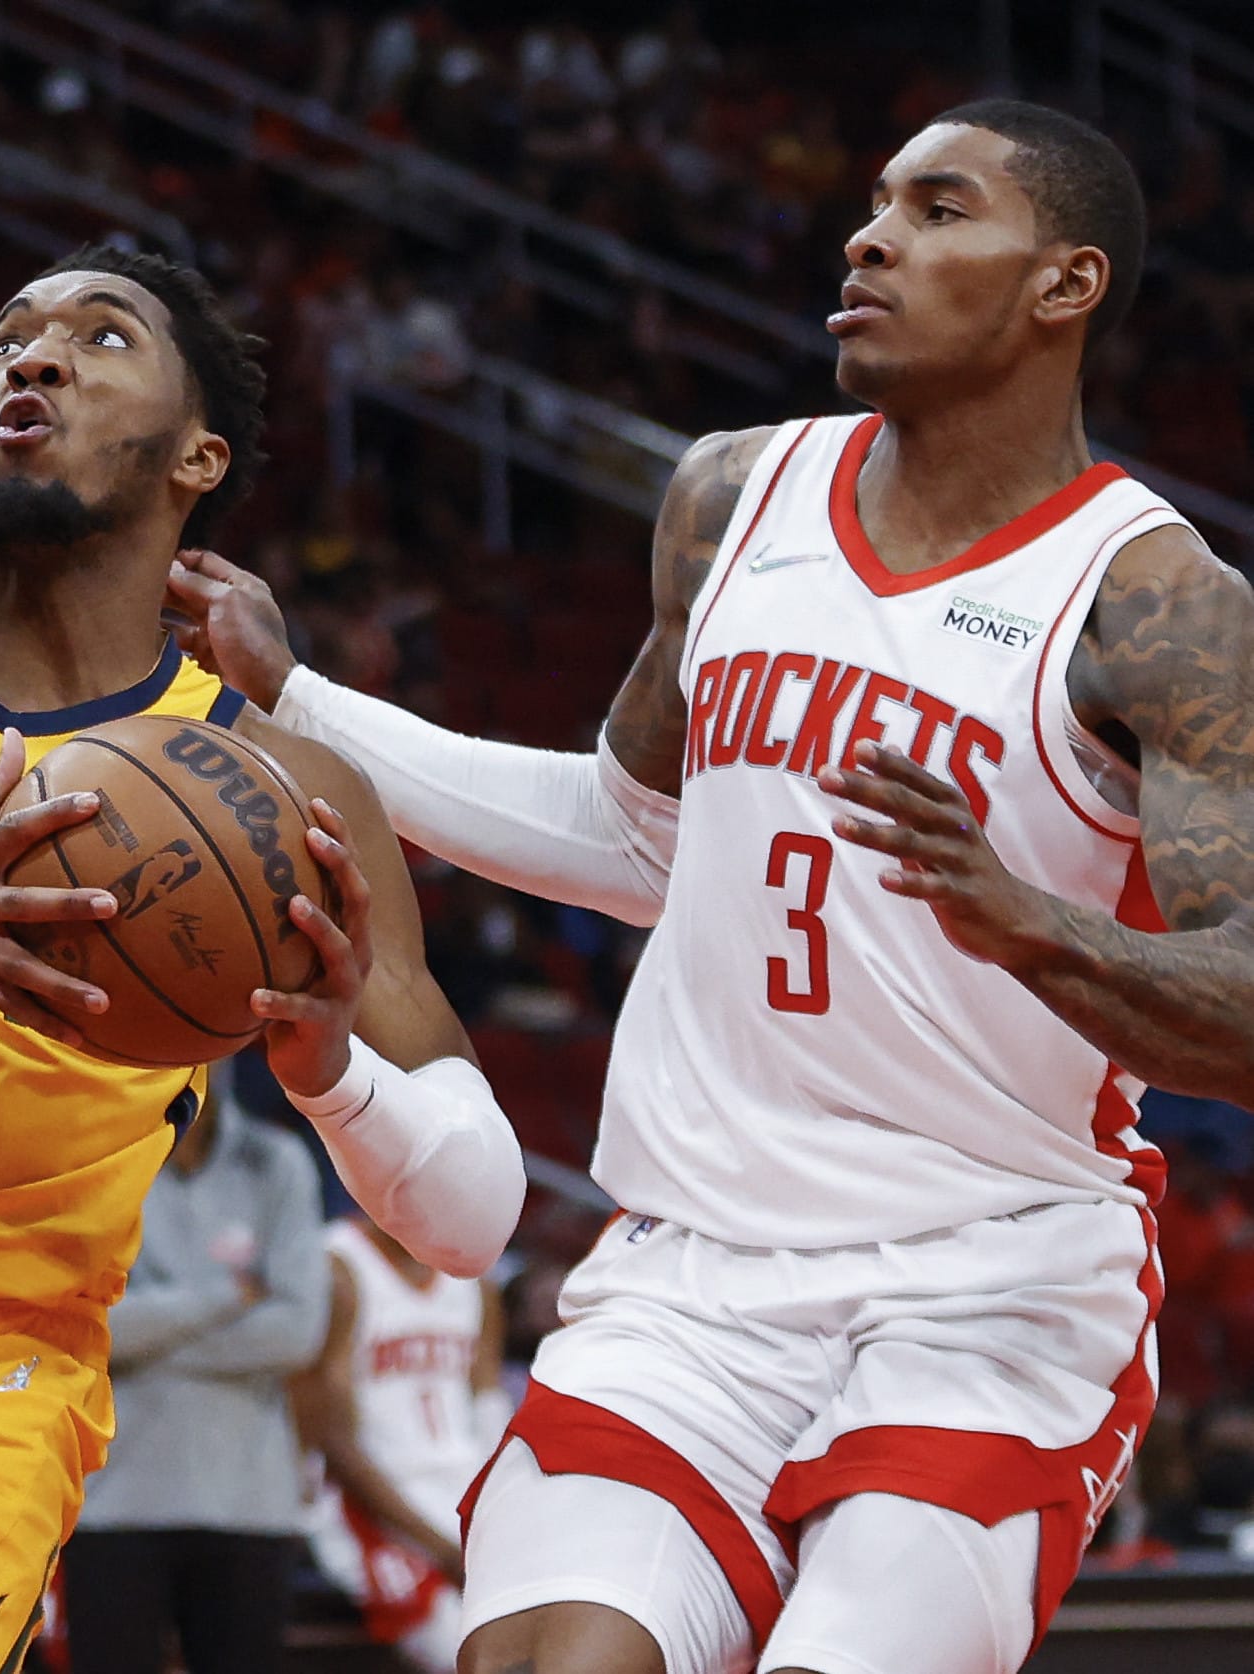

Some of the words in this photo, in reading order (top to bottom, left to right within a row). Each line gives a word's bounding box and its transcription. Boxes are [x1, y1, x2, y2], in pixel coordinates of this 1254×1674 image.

[943, 607, 1038, 650] MONEY
[952, 596, 995, 618] credit
[997, 608, 1044, 631] karma
[765, 831, 834, 1016] 3
